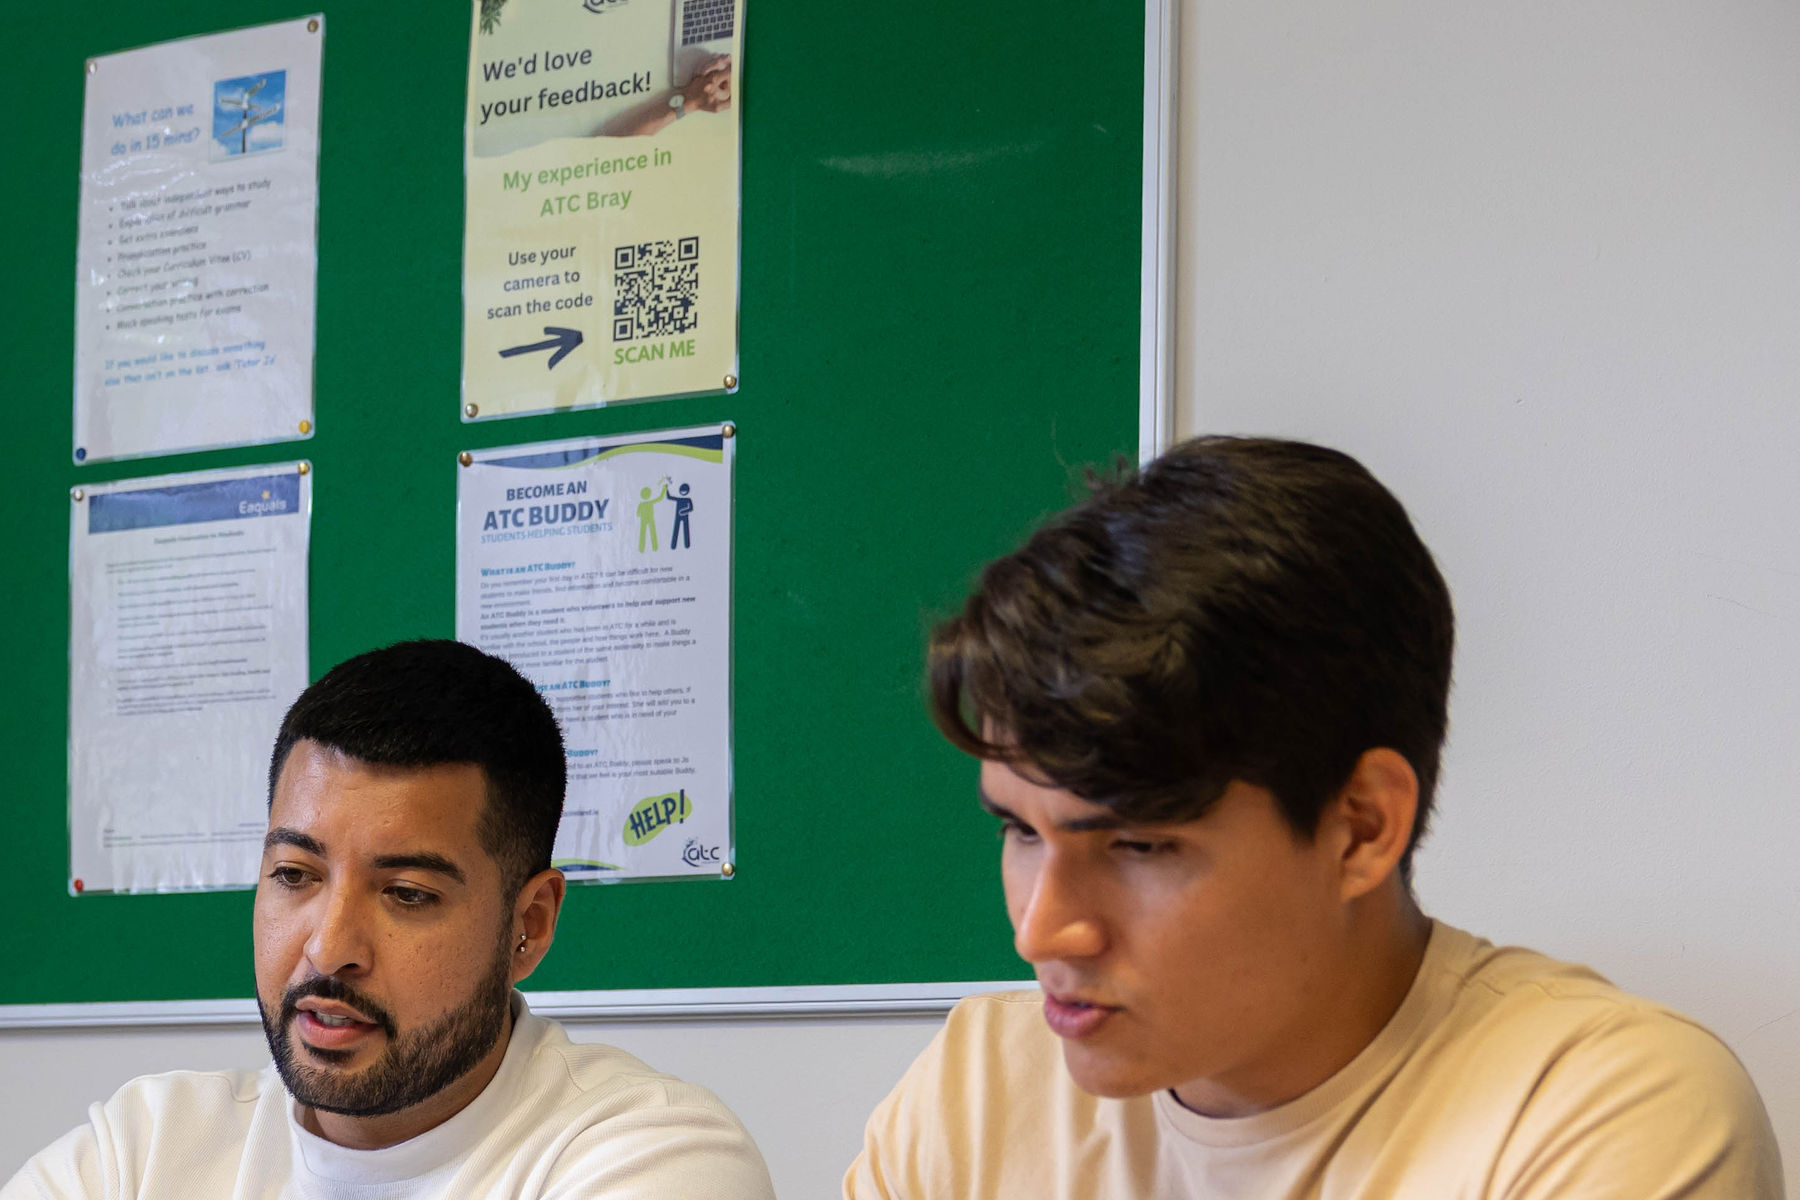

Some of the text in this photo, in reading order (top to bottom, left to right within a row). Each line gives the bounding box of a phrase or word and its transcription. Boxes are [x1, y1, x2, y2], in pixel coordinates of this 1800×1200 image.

[483, 49, 593, 82] We'd love
[480, 71, 652, 125] your feedback!
[112, 103, 194, 128] What can we
[110, 126, 201, 156] do in 15 mins?
[503, 148, 672, 193] My experience in
[215, 185, 234, 198] ways
[236, 182, 246, 192] to
[247, 179, 272, 192] study
[179, 204, 213, 219] difficult
[214, 200, 251, 217] grammar
[540, 189, 632, 218] ATC Bray
[172, 241, 207, 255] practice
[232, 249, 253, 263] (CV)
[508, 246, 576, 267] Use your
[205, 289, 223, 300] with
[225, 283, 270, 297] correction
[503, 270, 580, 292] camera to
[139, 314, 174, 328] speaking
[199, 306, 214, 319] for
[215, 304, 242, 315] exams
[487, 292, 593, 320] scan the code
[613, 339, 696, 365] SCAN ME
[506, 480, 587, 501] BECOME AN
[239, 498, 287, 517] Eaquals
[483, 498, 610, 531] ATC BUDDY
[481, 521, 613, 544] STUDENTS HELPING STUDENTS
[527, 563, 543, 572] ATC
[561, 680, 578, 689] ATC
[629, 789, 686, 840] HELP!
